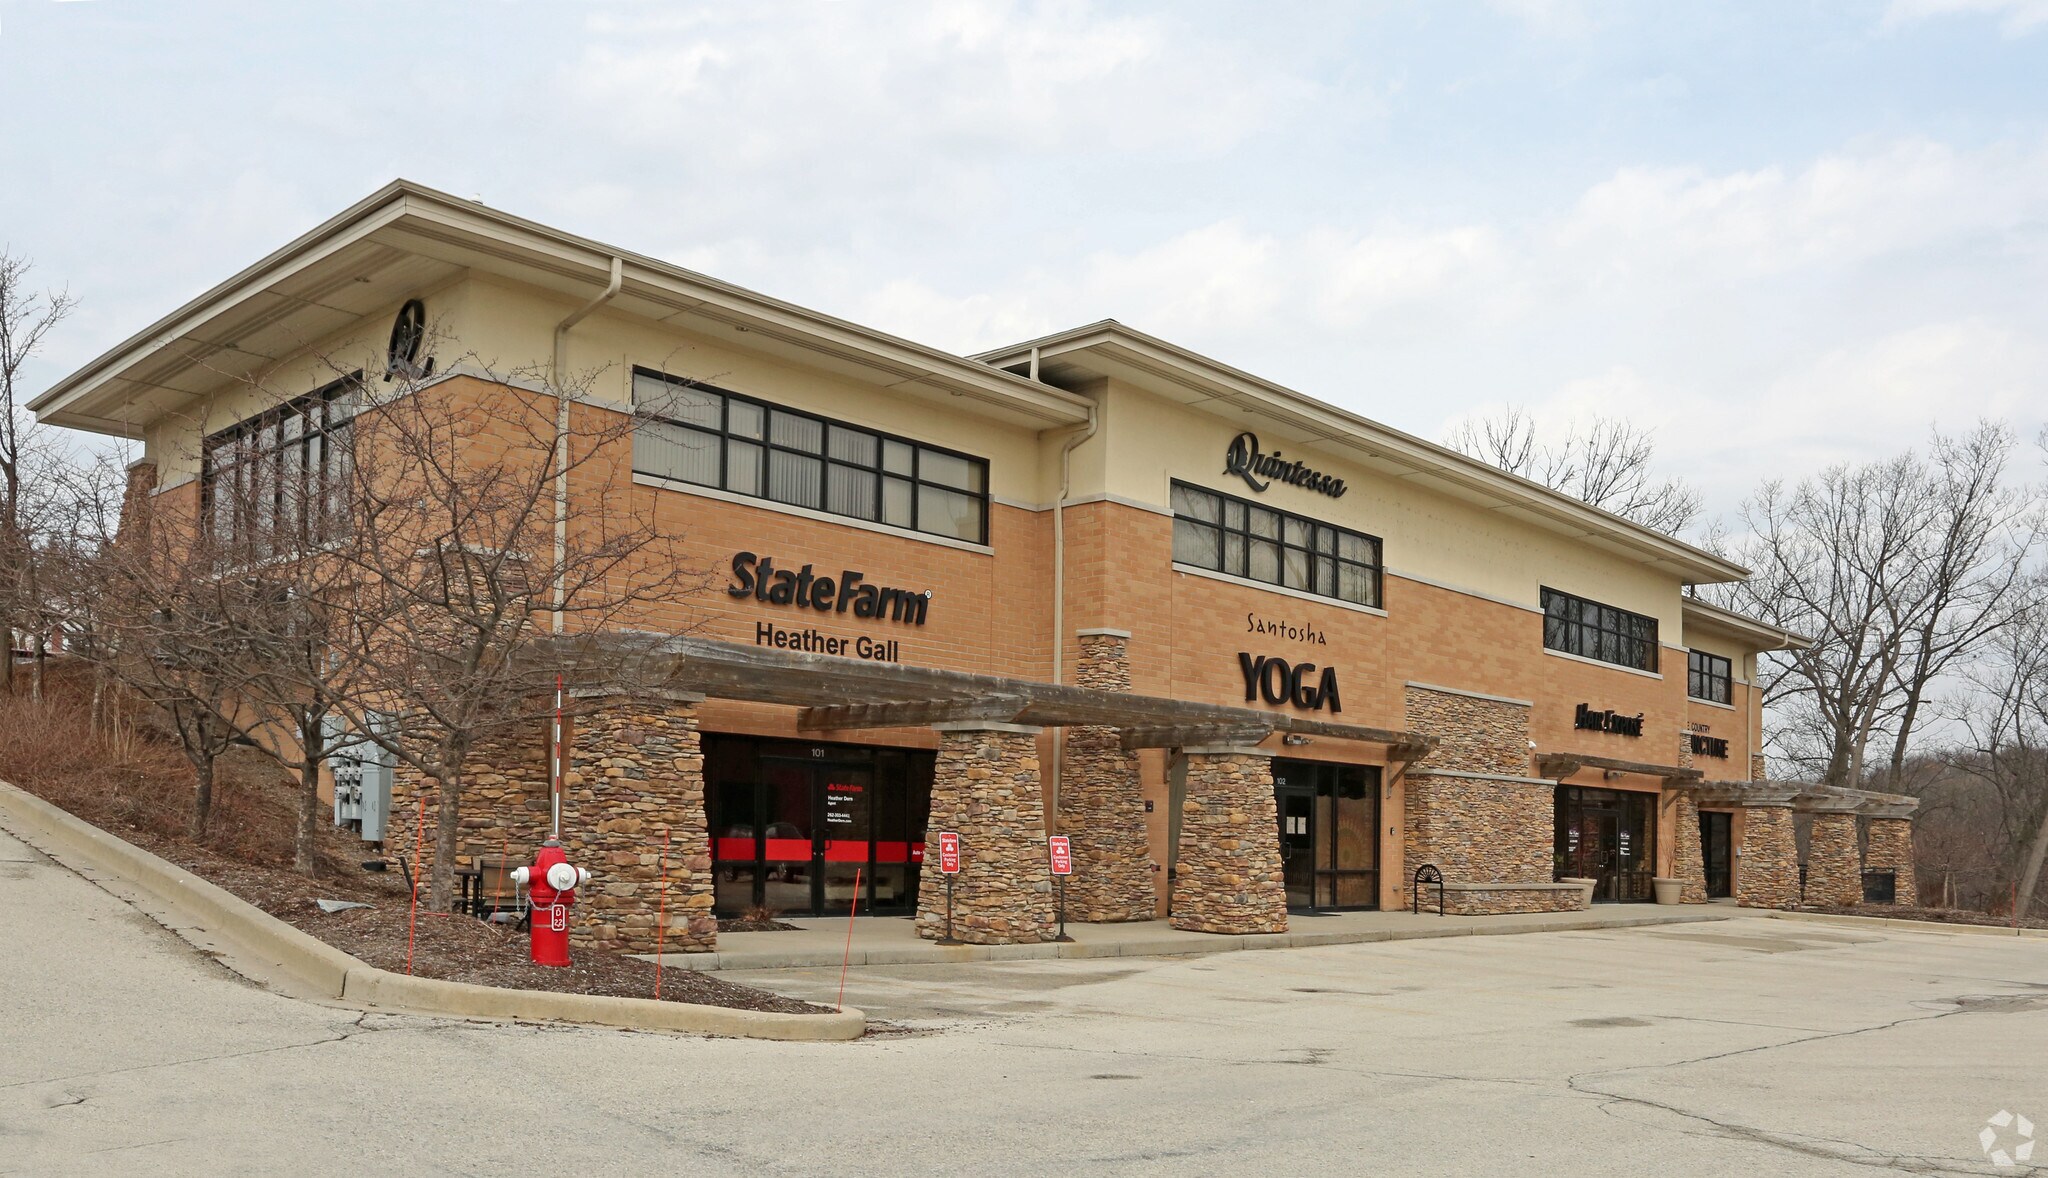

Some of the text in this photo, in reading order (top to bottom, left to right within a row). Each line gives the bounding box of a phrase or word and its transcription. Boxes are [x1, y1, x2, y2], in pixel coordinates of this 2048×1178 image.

[1222, 431, 1348, 499] Quintessa
[1247, 612, 1327, 646] Santosha
[756, 621, 899, 663] Heather Gall
[1238, 652, 1342, 713] YOGA
[1691, 722, 1710, 734] COUNTRY
[812, 748, 824, 757] 101
[1277, 777, 1286, 785] 102
[554, 918, 563, 926] 22
